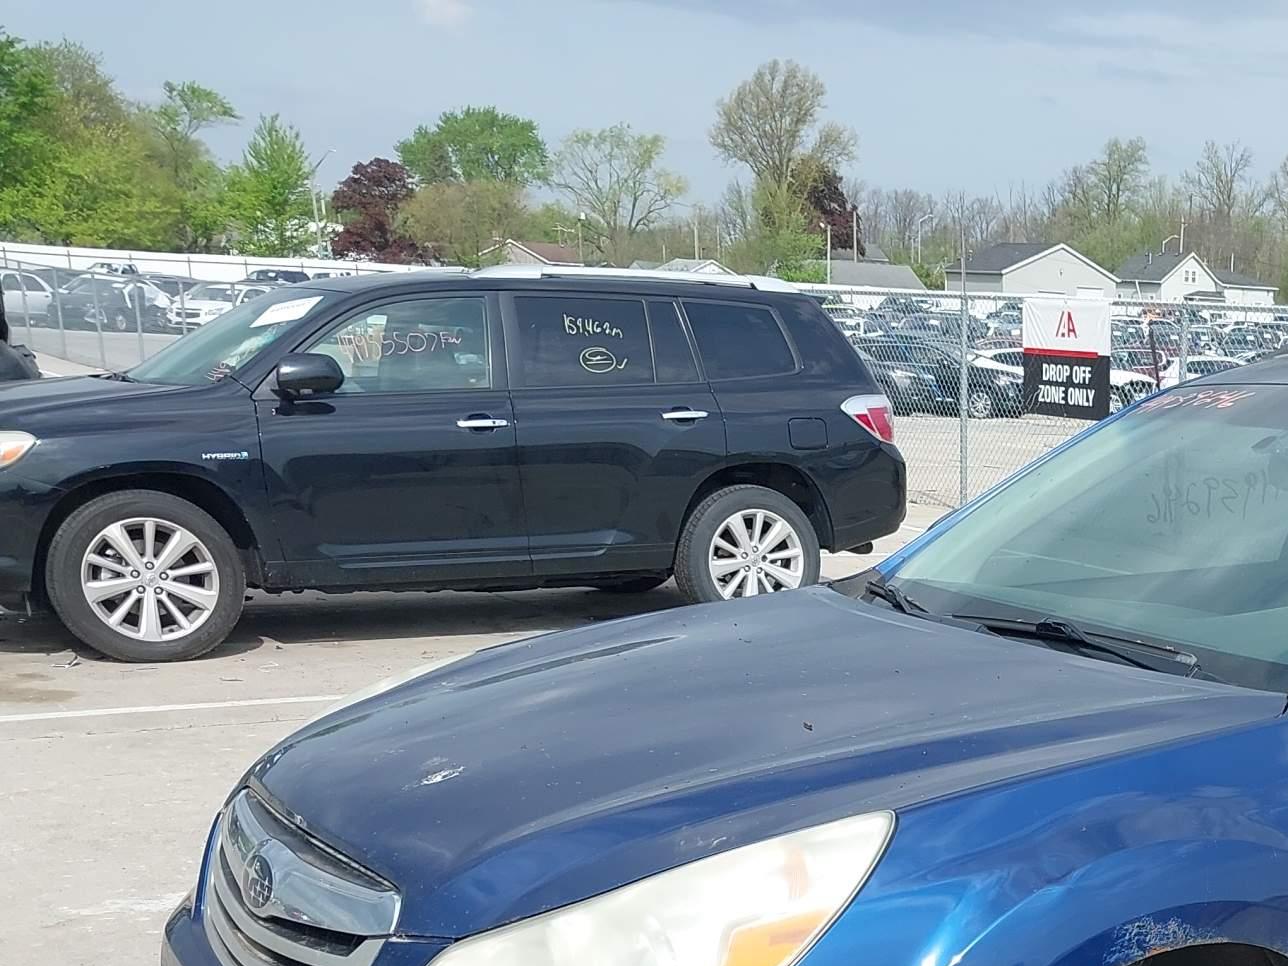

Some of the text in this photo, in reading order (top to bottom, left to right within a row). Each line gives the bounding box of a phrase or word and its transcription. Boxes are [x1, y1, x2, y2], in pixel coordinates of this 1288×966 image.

[1042, 363, 1092, 385] DROP OFF
[1038, 384, 1096, 408] ZONE ONLY
